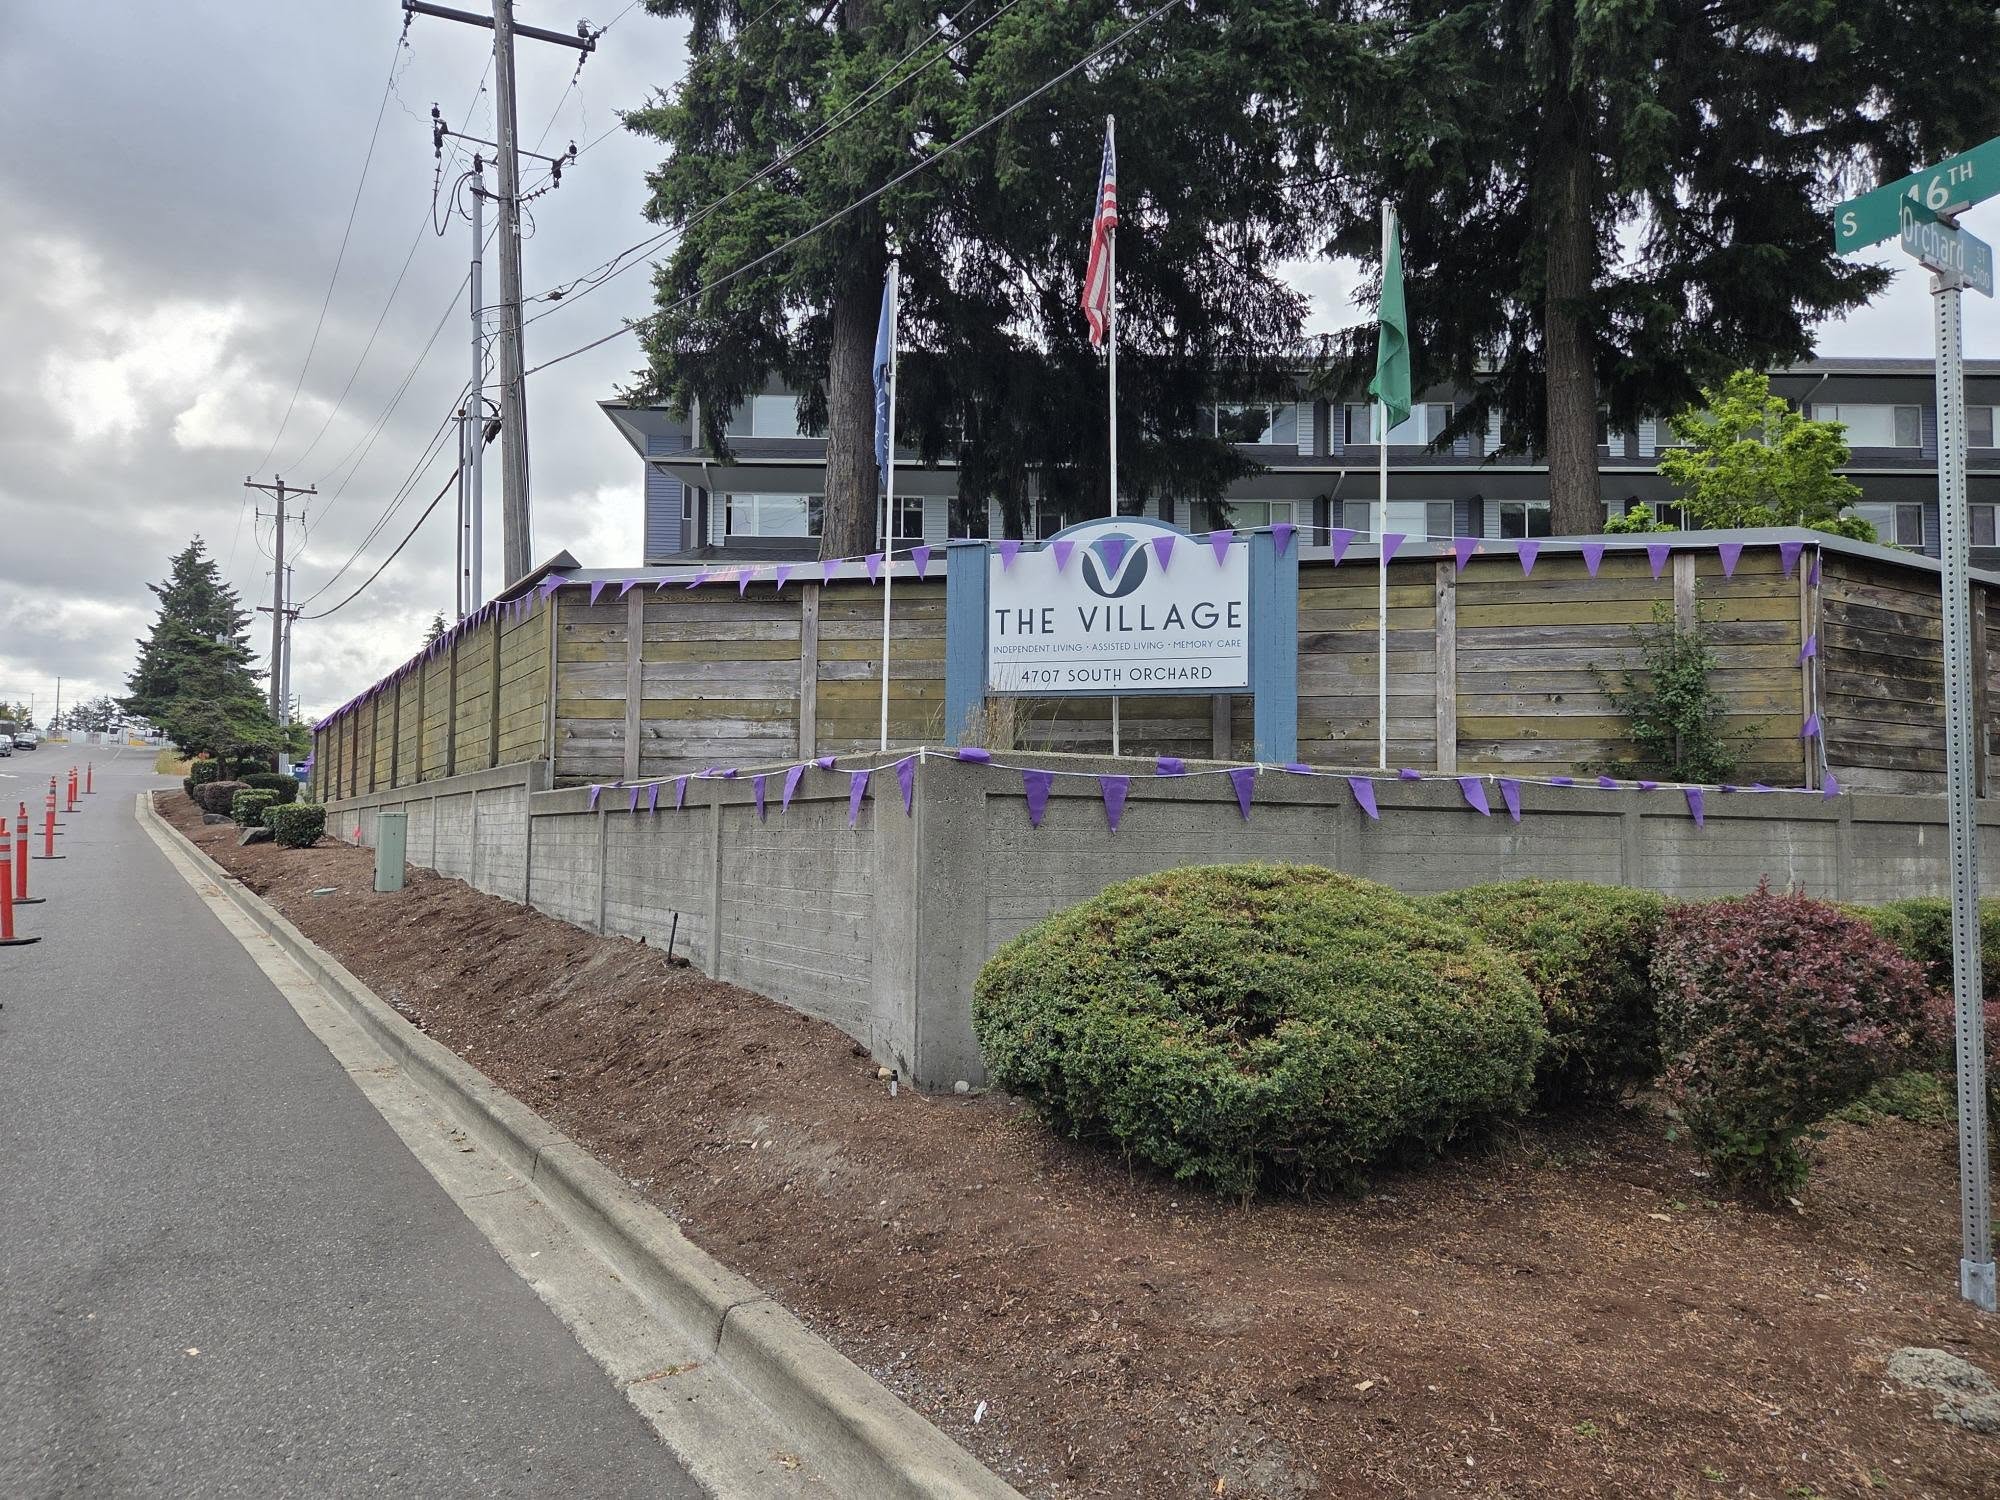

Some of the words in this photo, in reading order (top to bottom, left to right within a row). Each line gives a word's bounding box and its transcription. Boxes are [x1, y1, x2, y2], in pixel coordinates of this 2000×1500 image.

[1842, 211, 1858, 238] S
[1903, 205, 1964, 271] Orchard
[995, 607, 1055, 635] THE
[1077, 601, 1242, 632] VILLAGE
[993, 644, 1050, 654] INDEPENDENT
[1053, 643, 1083, 653] LIVING
[1091, 642, 1131, 651] ASSISTED
[1133, 641, 1164, 650] LIVING
[1173, 640, 1213, 648] MEMORY
[1217, 639, 1242, 648] CARE
[1021, 670, 1060, 683] 4707
[1068, 668, 1121, 682] SOUTH
[1129, 666, 1212, 681] ORCHARD
